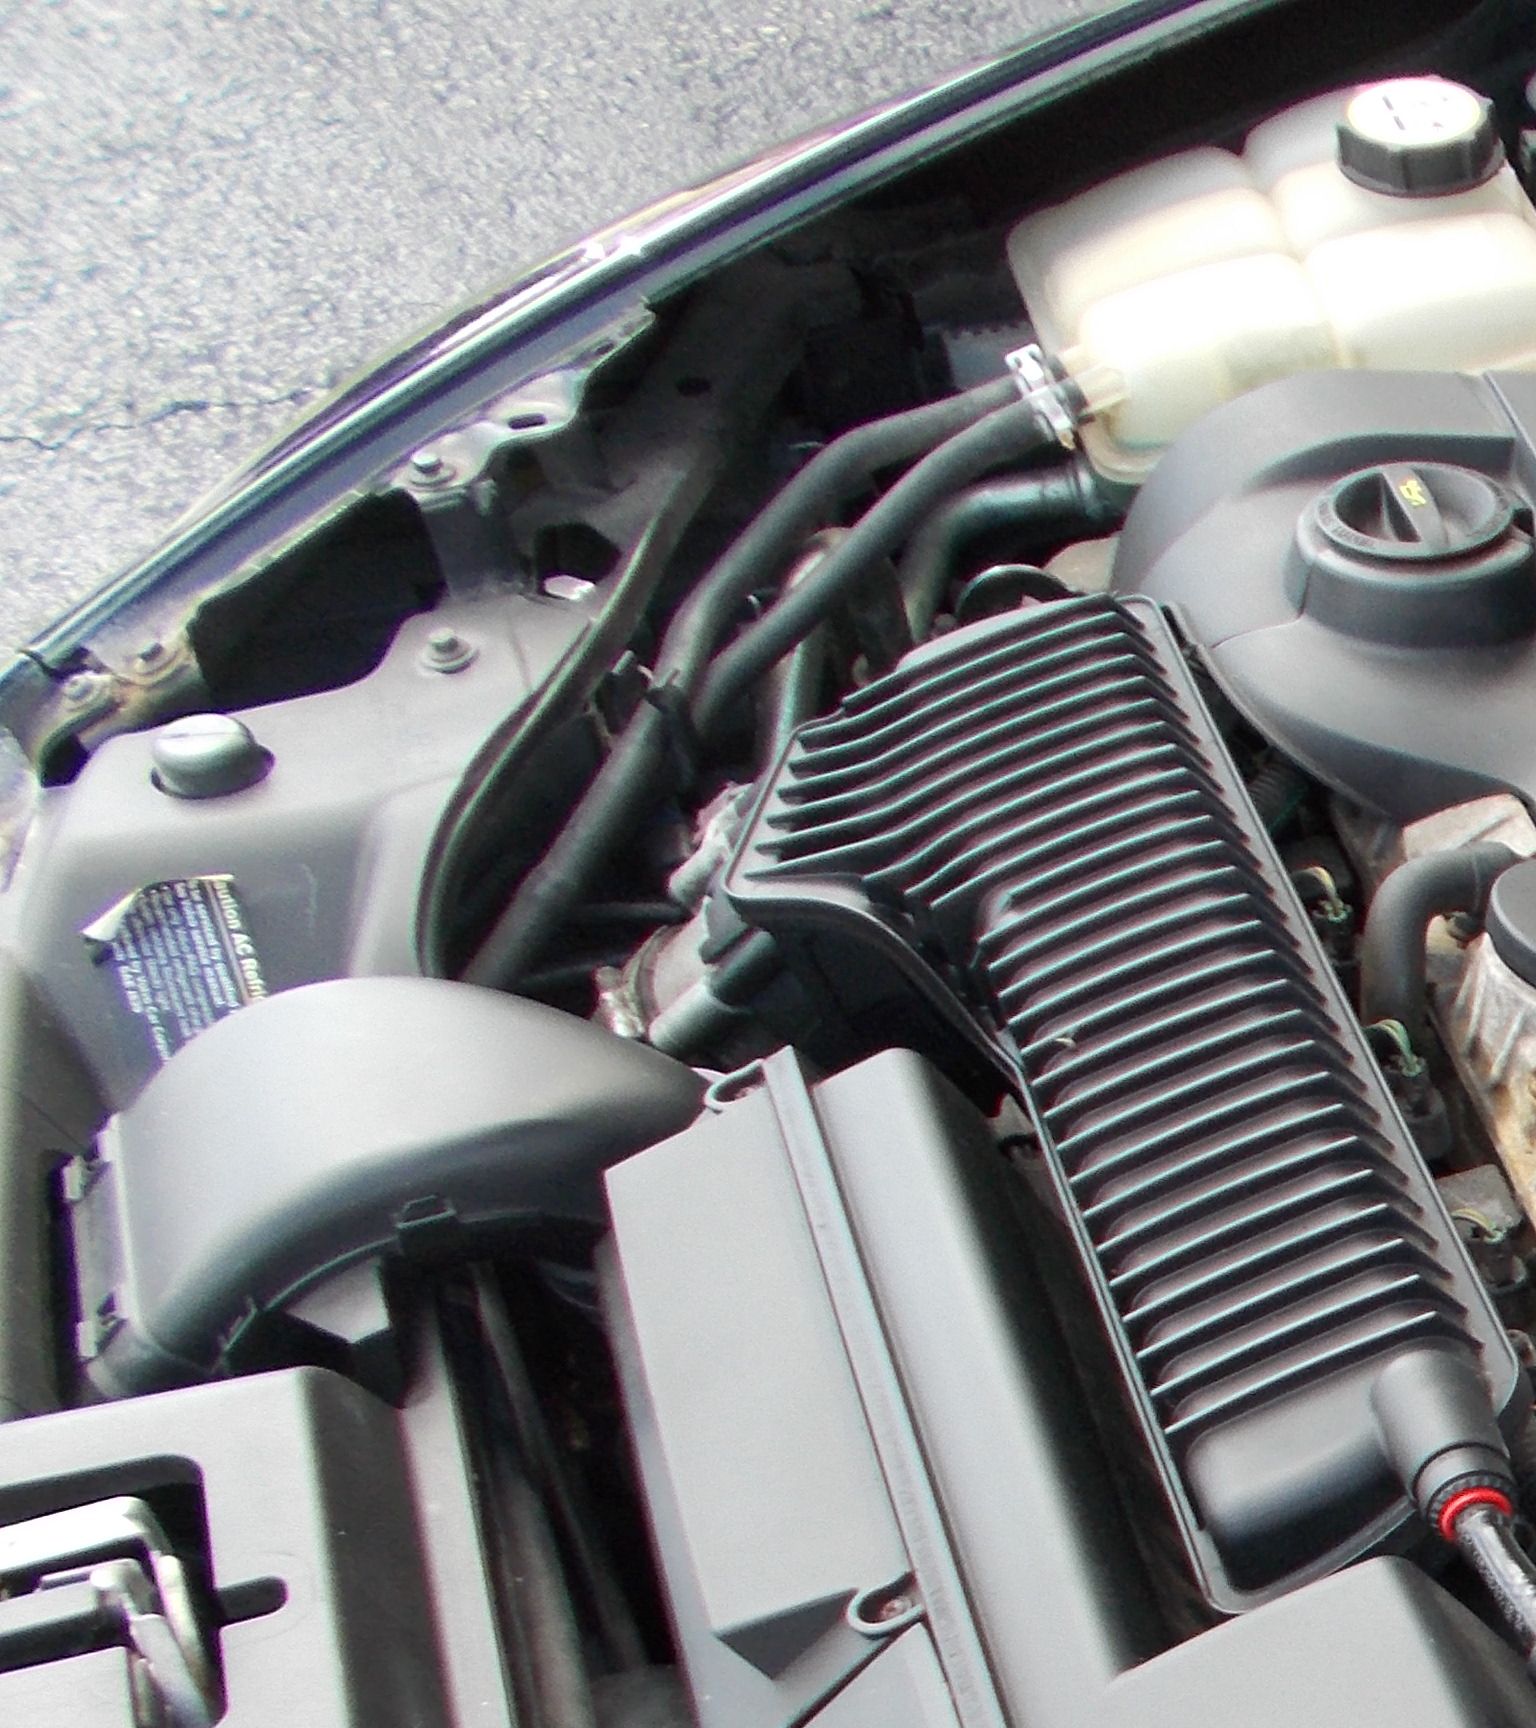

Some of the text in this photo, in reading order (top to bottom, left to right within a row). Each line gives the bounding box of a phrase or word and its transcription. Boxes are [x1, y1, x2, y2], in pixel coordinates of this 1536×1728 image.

[212, 878, 269, 1003] aution AC Refri
[135, 974, 153, 1005] Volvo
